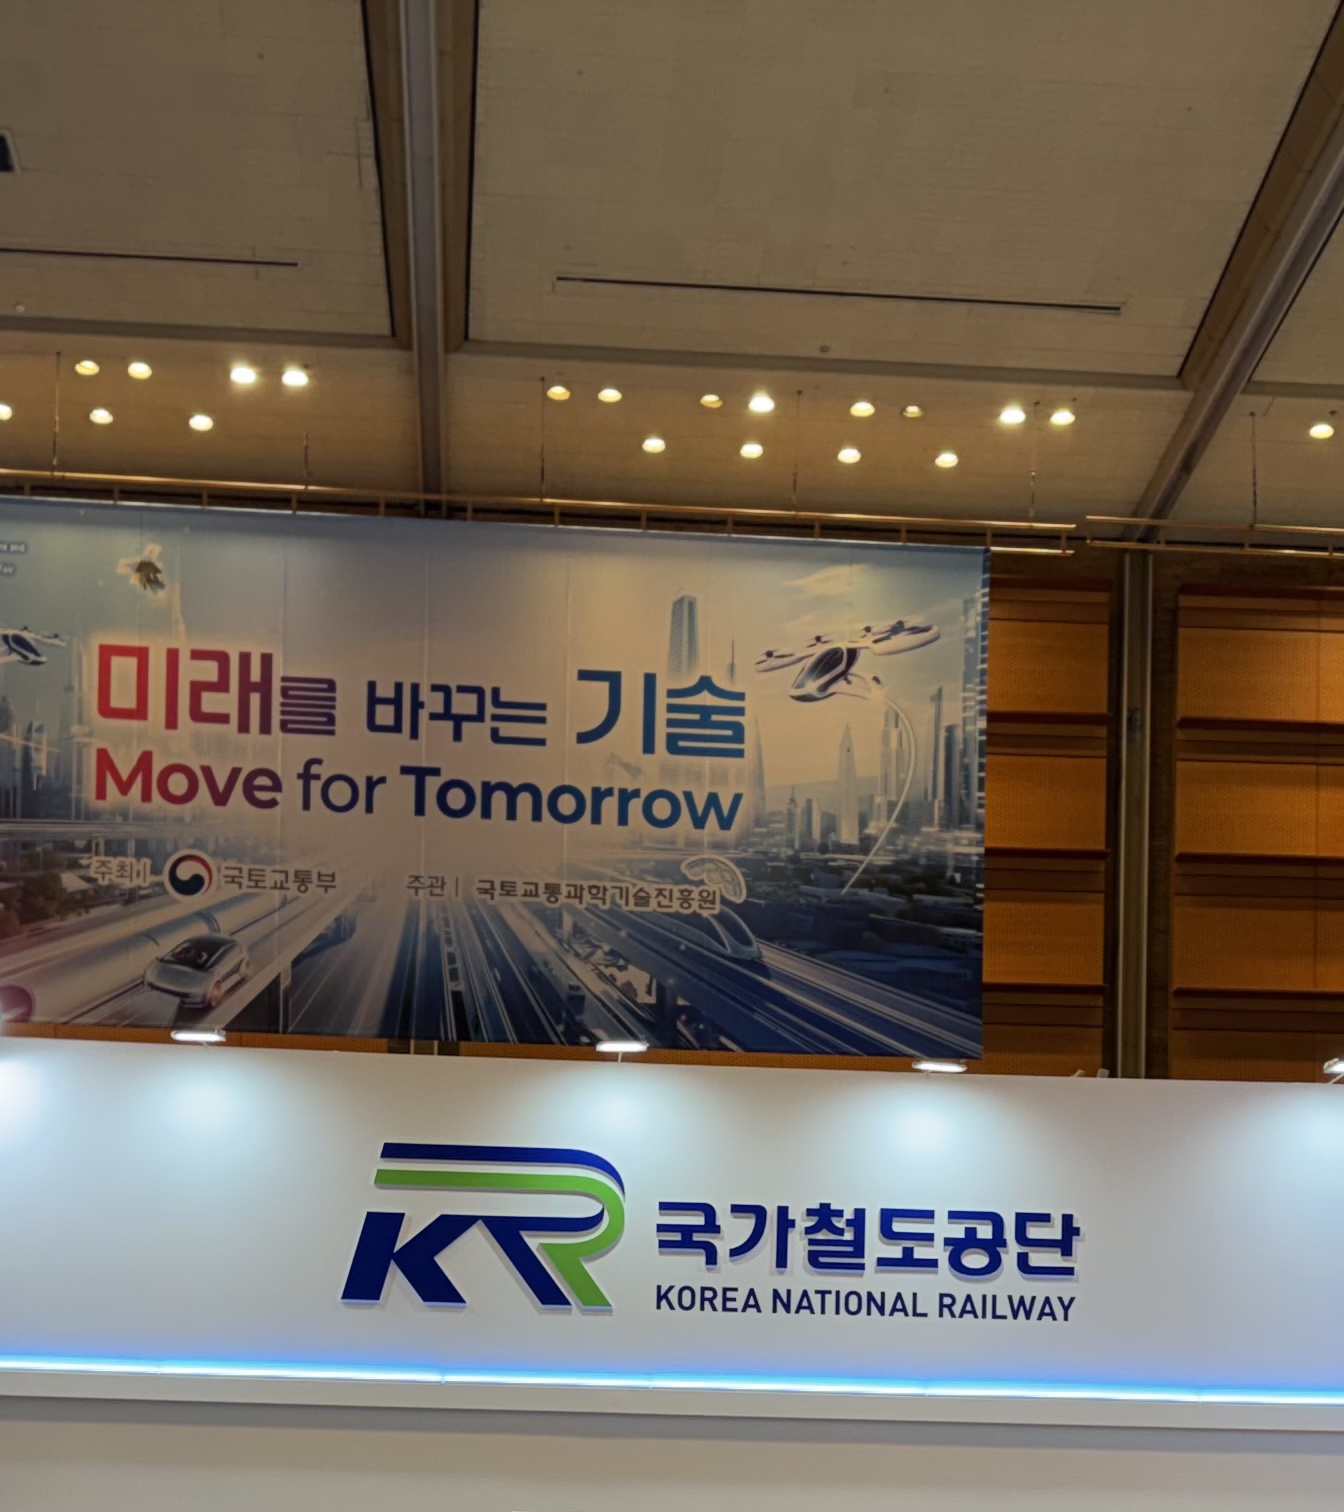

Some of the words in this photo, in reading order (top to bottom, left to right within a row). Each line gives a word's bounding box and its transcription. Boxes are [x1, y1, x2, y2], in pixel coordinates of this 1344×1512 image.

[98, 643, 336, 736] 미래를
[366, 679, 548, 747] 바꾸는
[576, 669, 746, 758] 기술
[94, 747, 283, 809] Move
[297, 758, 387, 814] for
[400, 765, 744, 831] Tomorrow
[94, 860, 134, 881] 주최
[222, 865, 338, 893] 국토교통부
[406, 874, 447, 897] 주관
[476, 879, 719, 911] 국토교통과학기술진흥원
[341, 1142, 626, 1308] KR
[656, 1201, 1081, 1276] 국가철도공단
[656, 1284, 763, 1314] KOREA
[771, 1288, 929, 1318] NATIONAL
[938, 1292, 1077, 1322] RAILWAY
